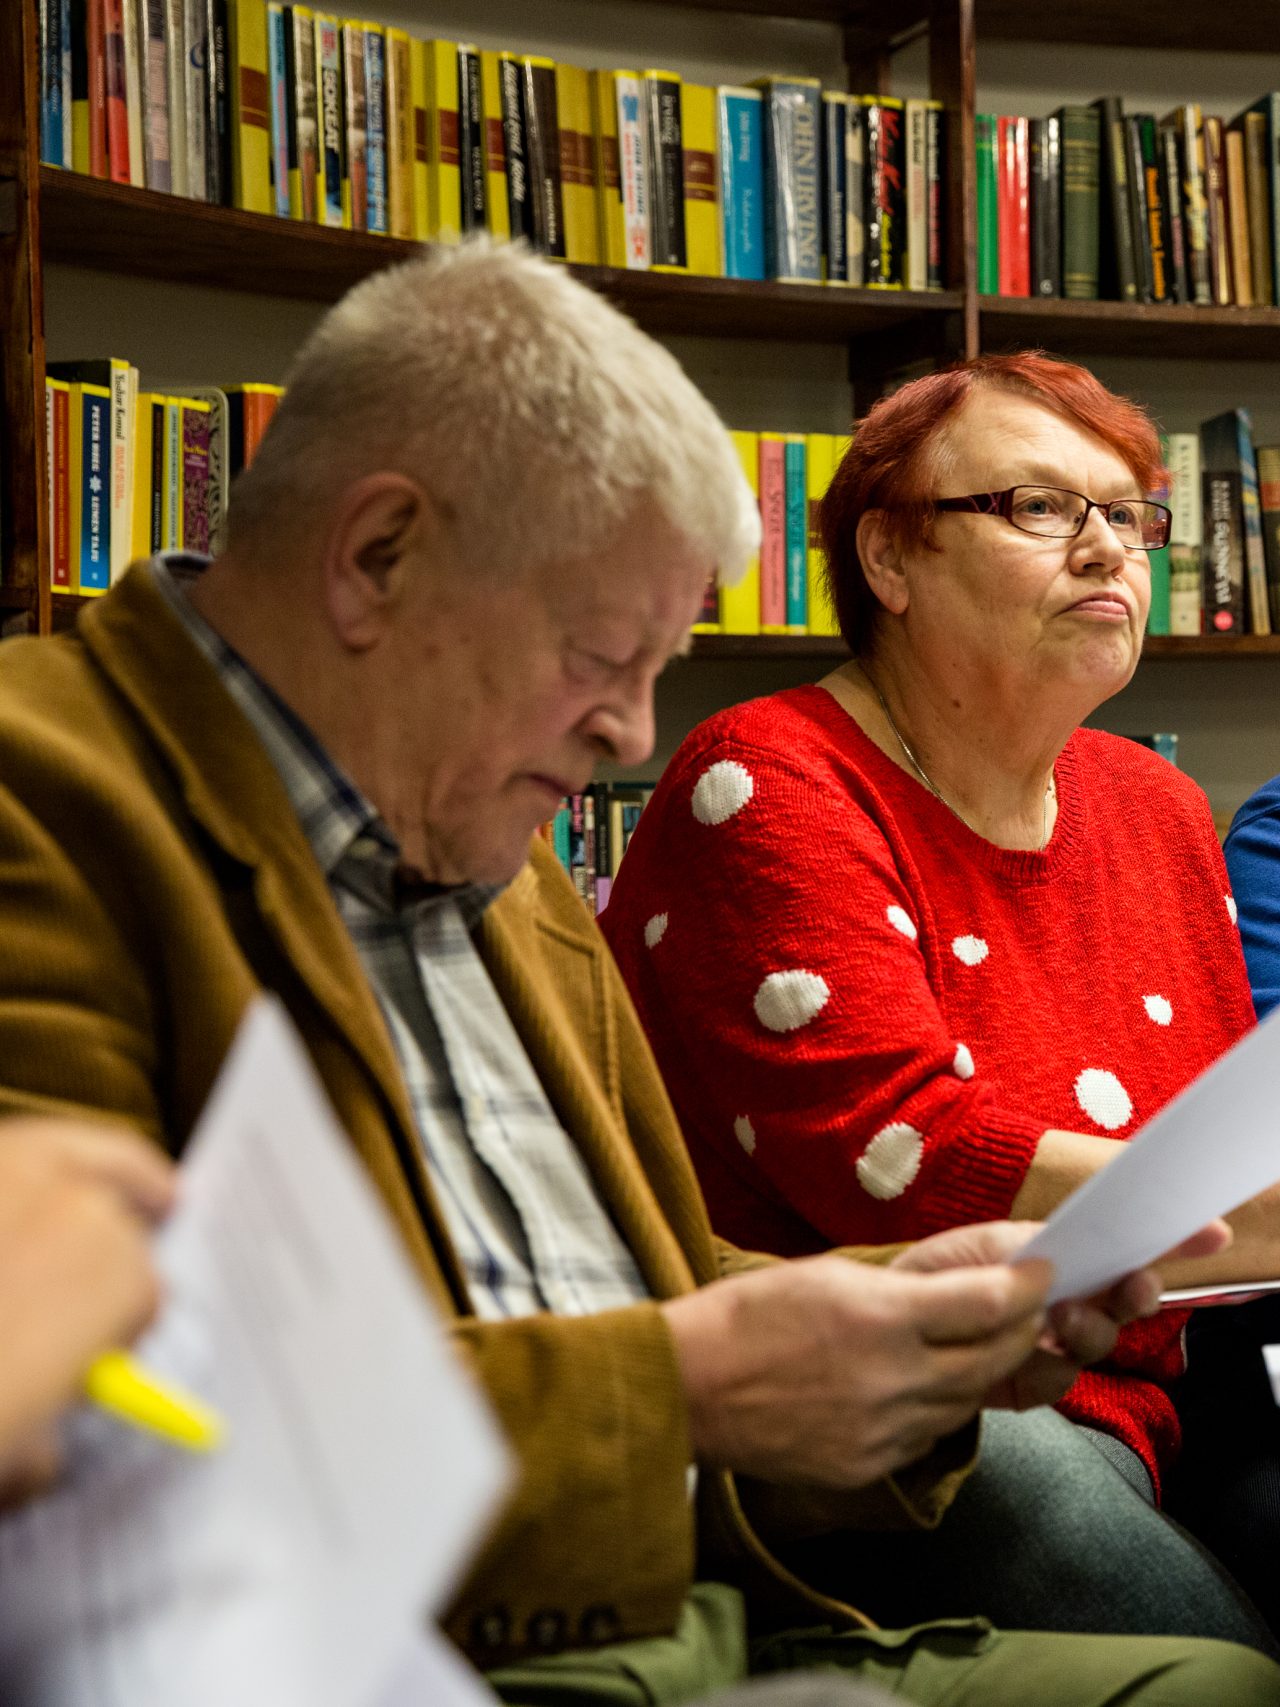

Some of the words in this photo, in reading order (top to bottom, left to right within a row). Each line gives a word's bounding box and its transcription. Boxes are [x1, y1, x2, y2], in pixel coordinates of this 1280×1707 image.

[795, 98, 817, 168] JOHN
[797, 173, 818, 269] IRVING
[91, 404, 102, 442] PETER
